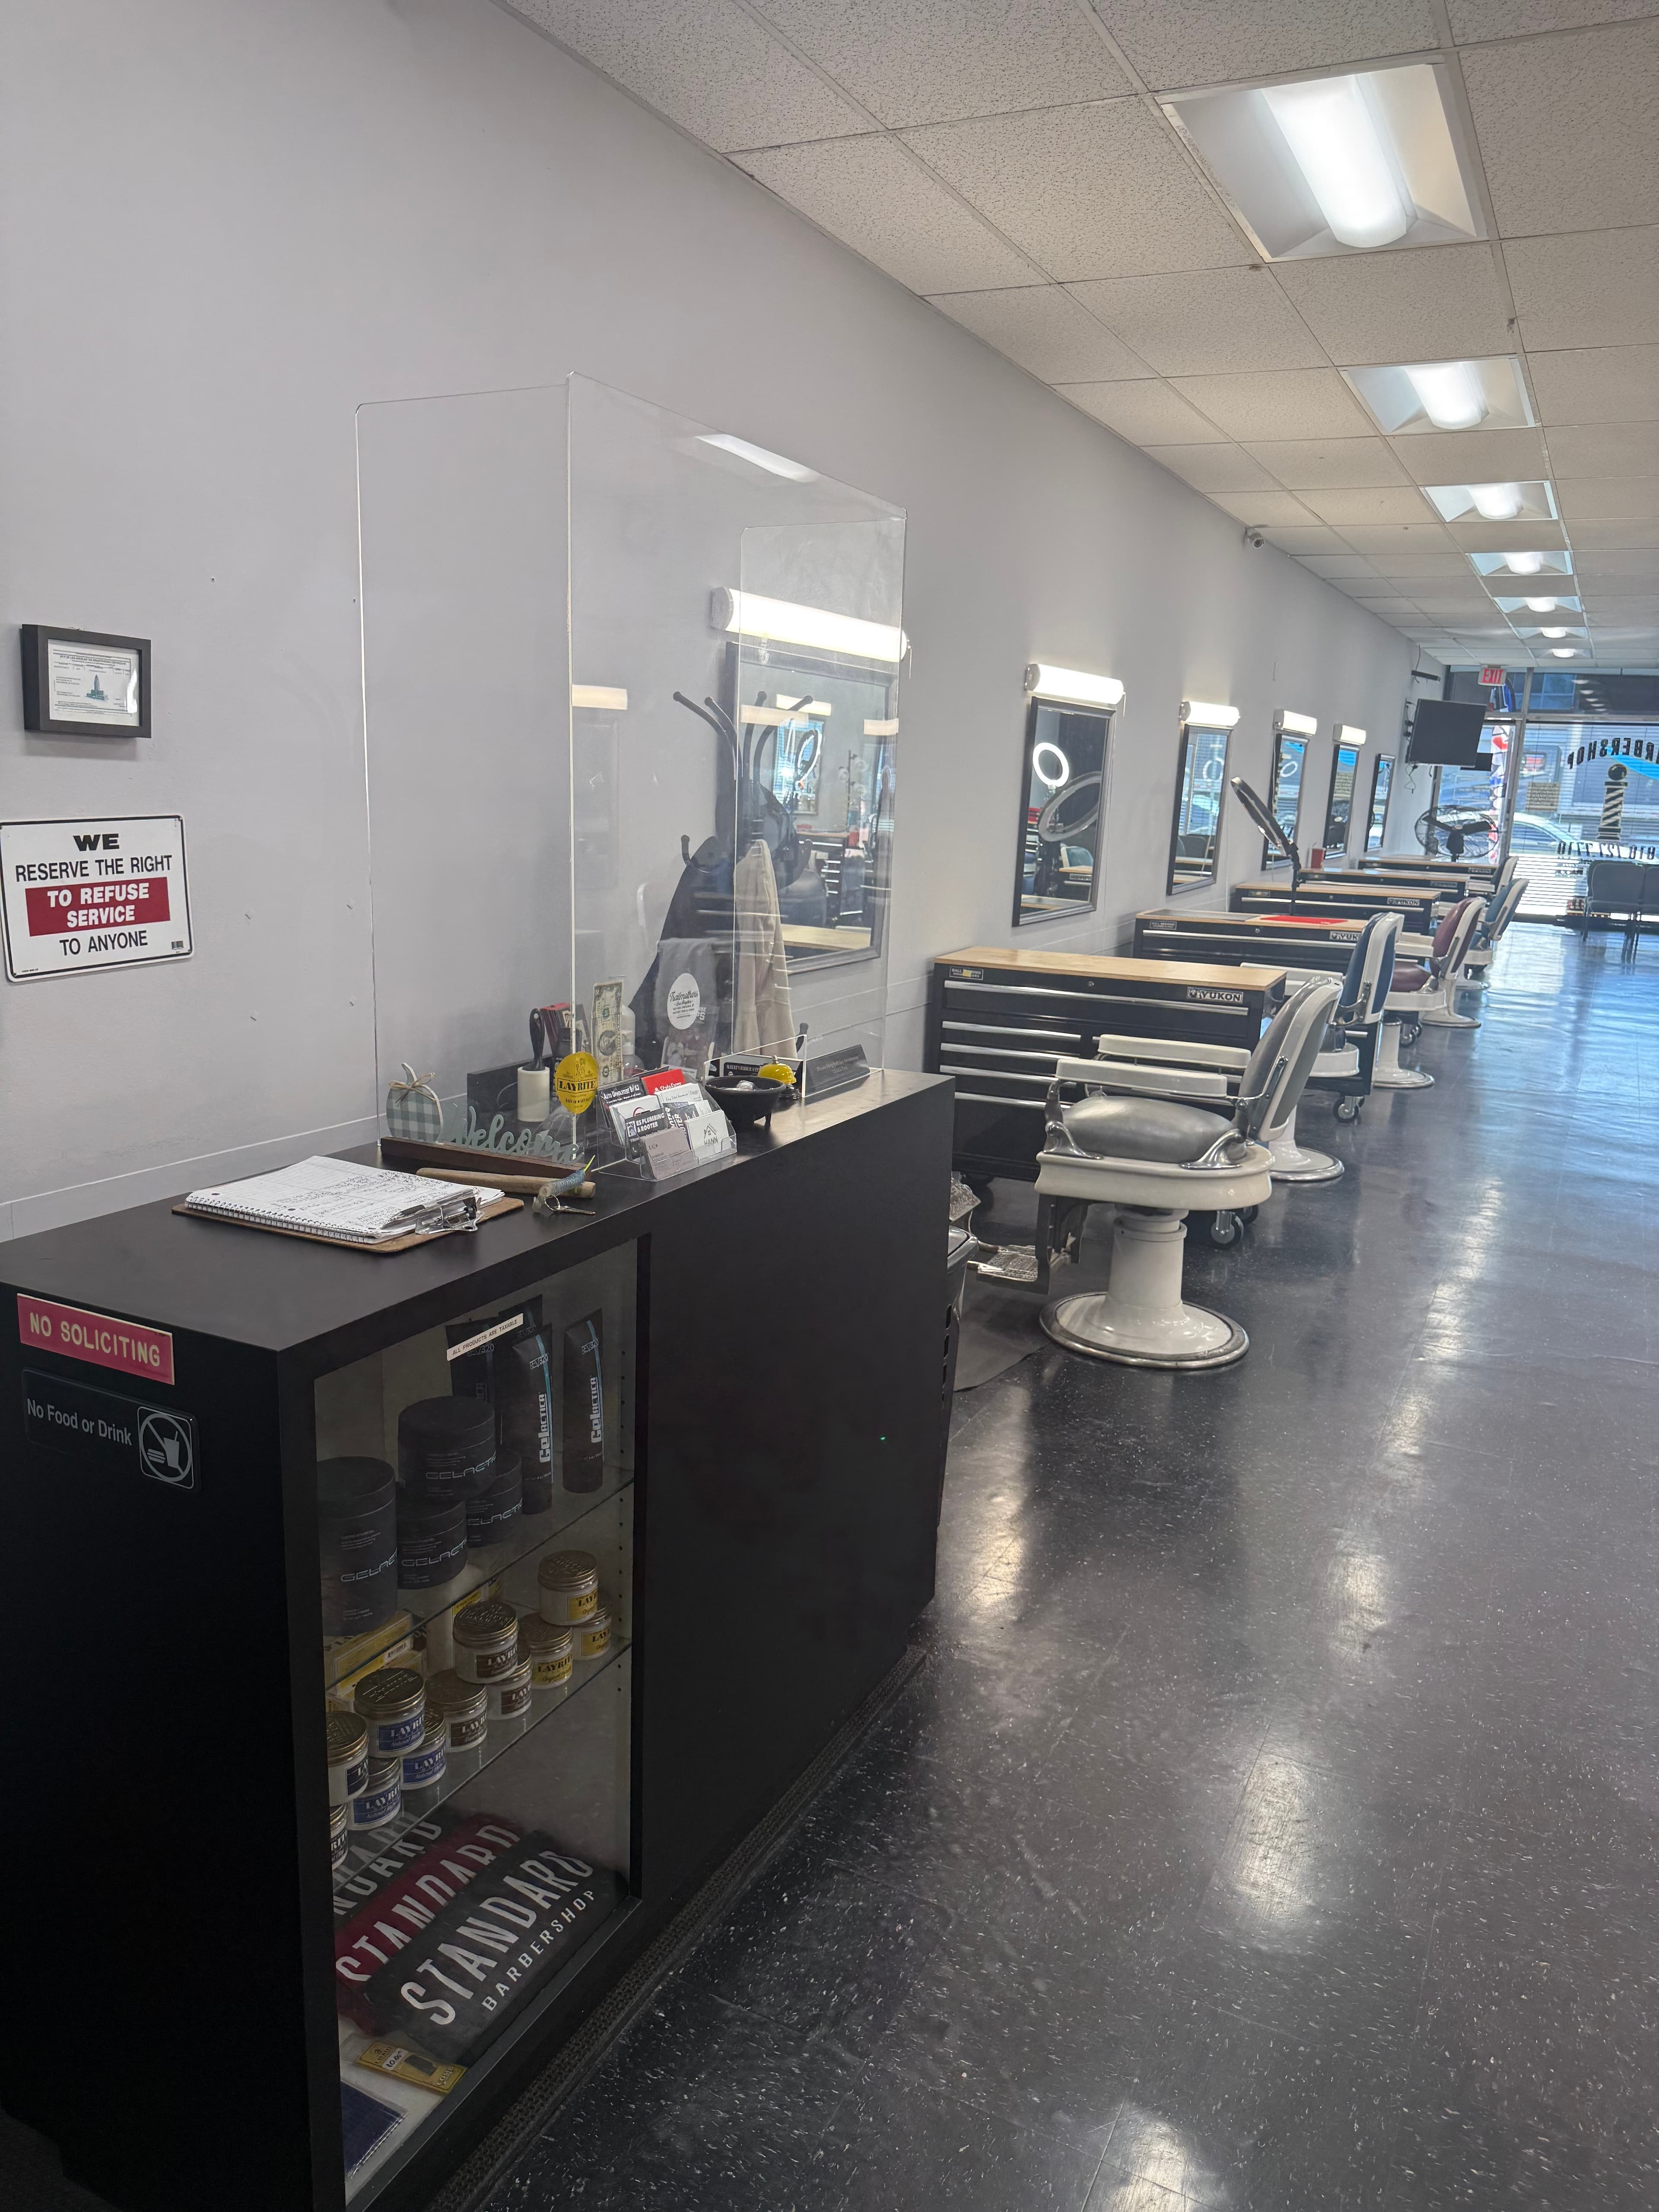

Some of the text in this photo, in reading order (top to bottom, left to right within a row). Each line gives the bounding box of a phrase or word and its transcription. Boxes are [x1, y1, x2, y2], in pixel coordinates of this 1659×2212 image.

[1482, 668, 1504, 684] EXIT
[73, 833, 120, 852] WE
[16, 855, 172, 882] RESERVE THE RIGHT
[47, 882, 149, 908] TO REFUSE
[67, 905, 135, 928] SERVICE
[60, 930, 148, 956] TO ANYONE
[1340, 932, 1360, 941] YUK
[1200, 991, 1241, 1002] YUKON
[559, 1080, 596, 1091] LAYRITE
[640, 1121, 658, 1132] ROOTER
[641, 1112, 665, 1125] PLUMBING
[444, 1103, 584, 1163] Welcome
[704, 1137, 718, 1145] HANN
[30, 1312, 160, 1367] NO SOLICITING
[462, 1334, 487, 1351] PRODUCTS
[488, 1328, 498, 1338] ARE
[498, 1319, 518, 1334] TAXABLE
[27, 1398, 132, 1446] No Food or Drink
[462, 1712, 487, 1733] LAYRI
[336, 1824, 521, 1982] STANDARD
[400, 1850, 594, 2026] STANDARD
[482, 1889, 595, 2012] BARBERSHOP
[436, 2065, 454, 2086] COMB
